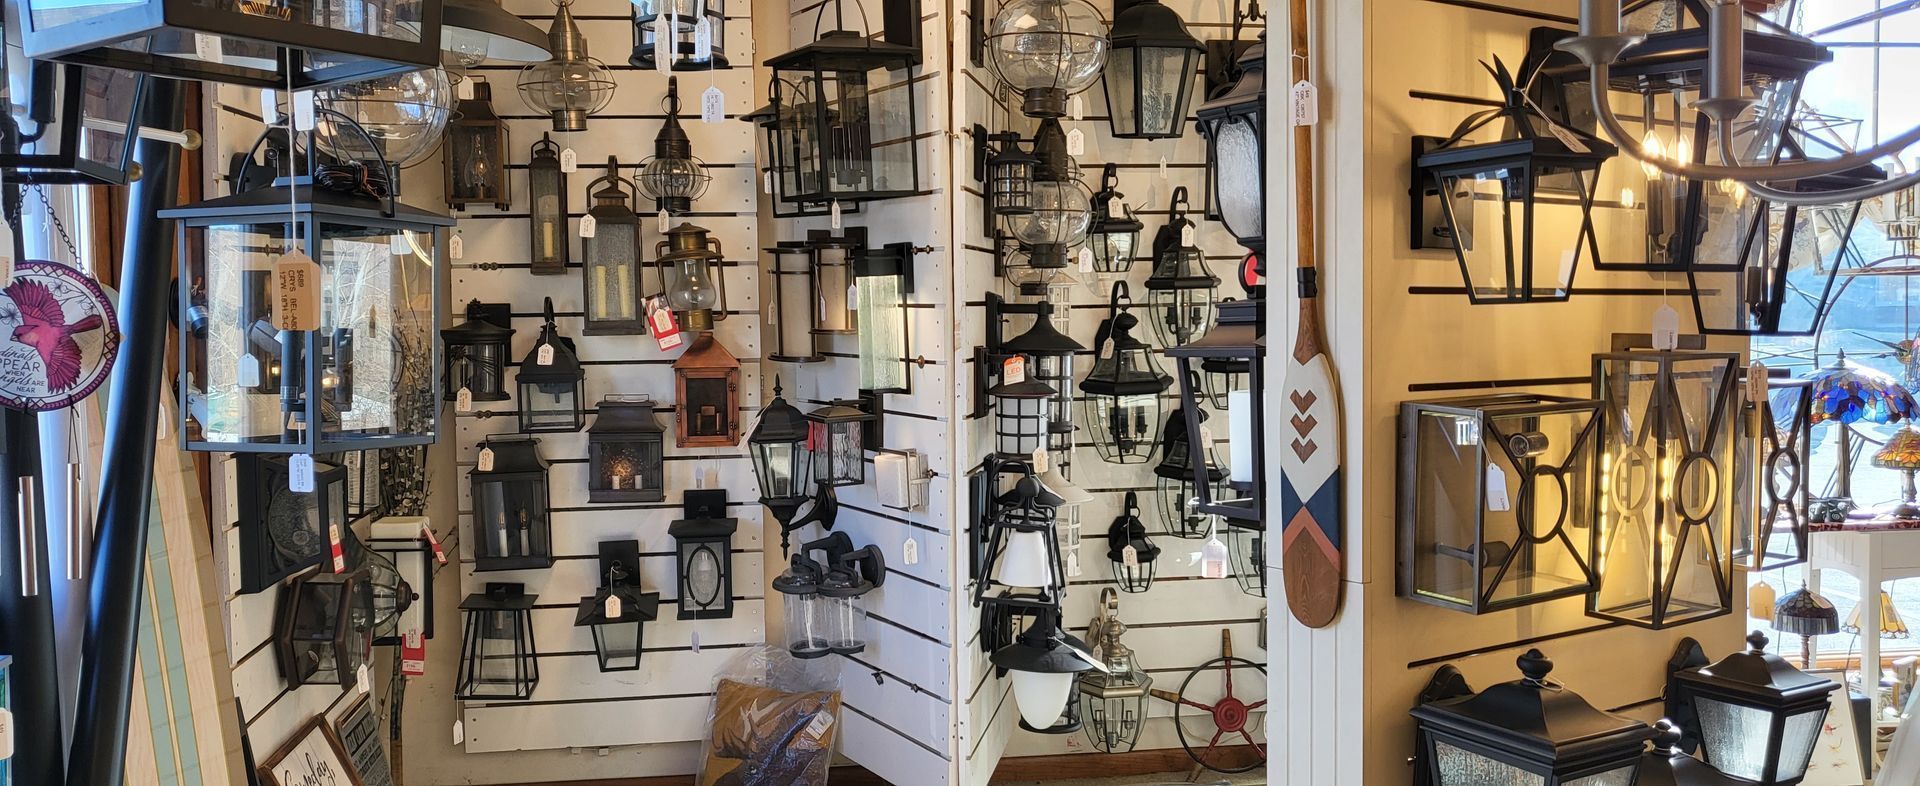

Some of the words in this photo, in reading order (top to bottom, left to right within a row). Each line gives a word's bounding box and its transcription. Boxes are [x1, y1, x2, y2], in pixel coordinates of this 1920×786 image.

[288, 269, 297, 292] CRYS
[4, 369, 26, 377] WHEN
[1007, 366, 1021, 376] LED
